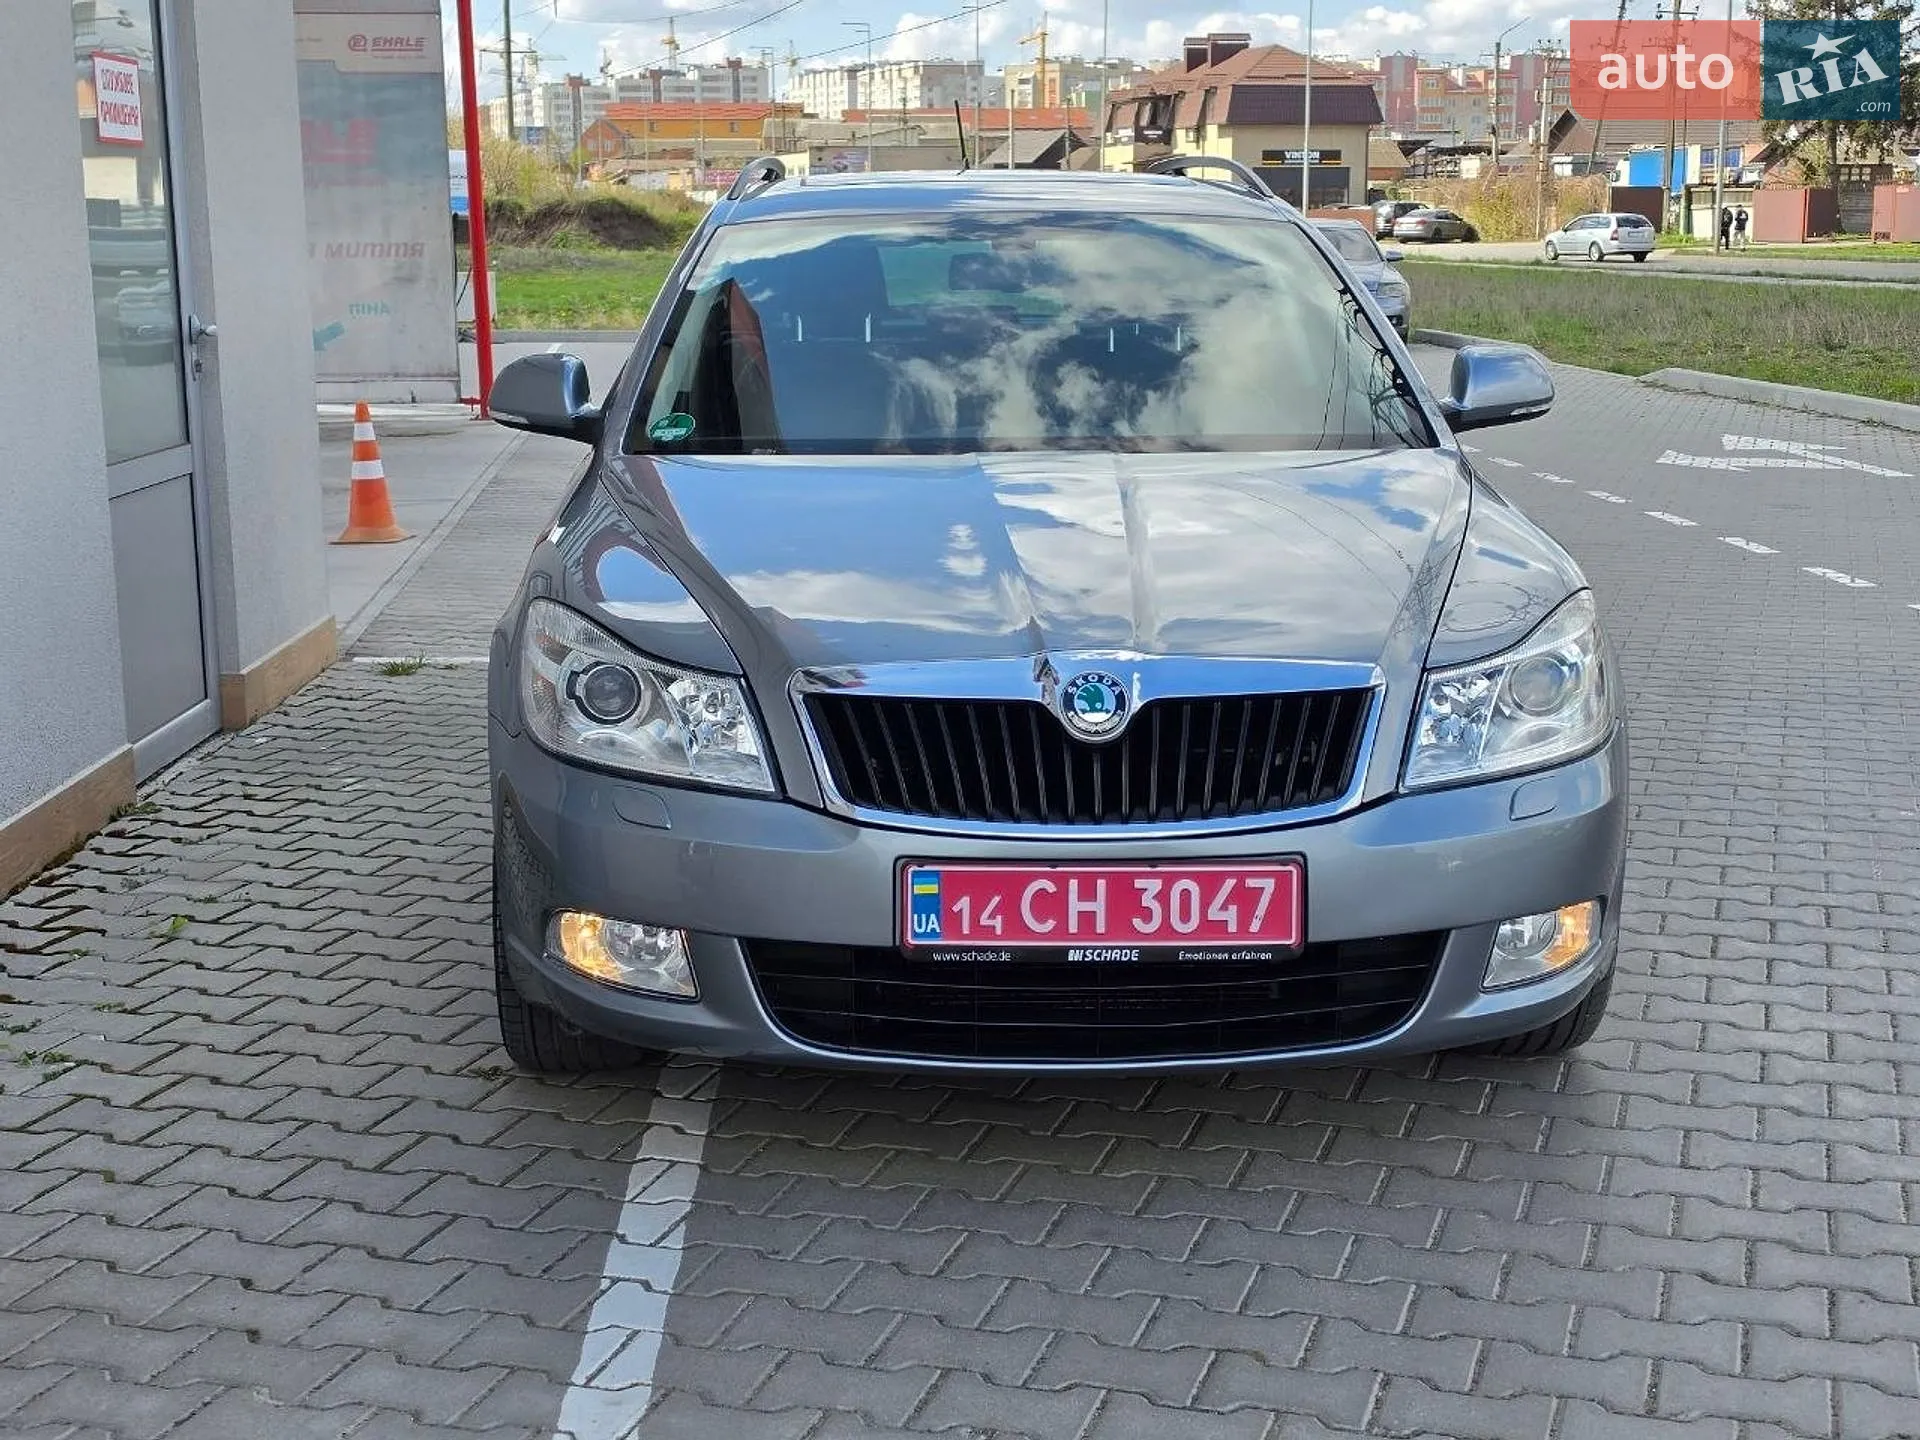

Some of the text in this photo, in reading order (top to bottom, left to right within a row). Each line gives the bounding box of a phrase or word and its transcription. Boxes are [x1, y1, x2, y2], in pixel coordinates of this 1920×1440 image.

[951, 878, 1276, 935] 14 CH 3047
[913, 913, 941, 933] UA
[932, 950, 1011, 962] www.schade.de
